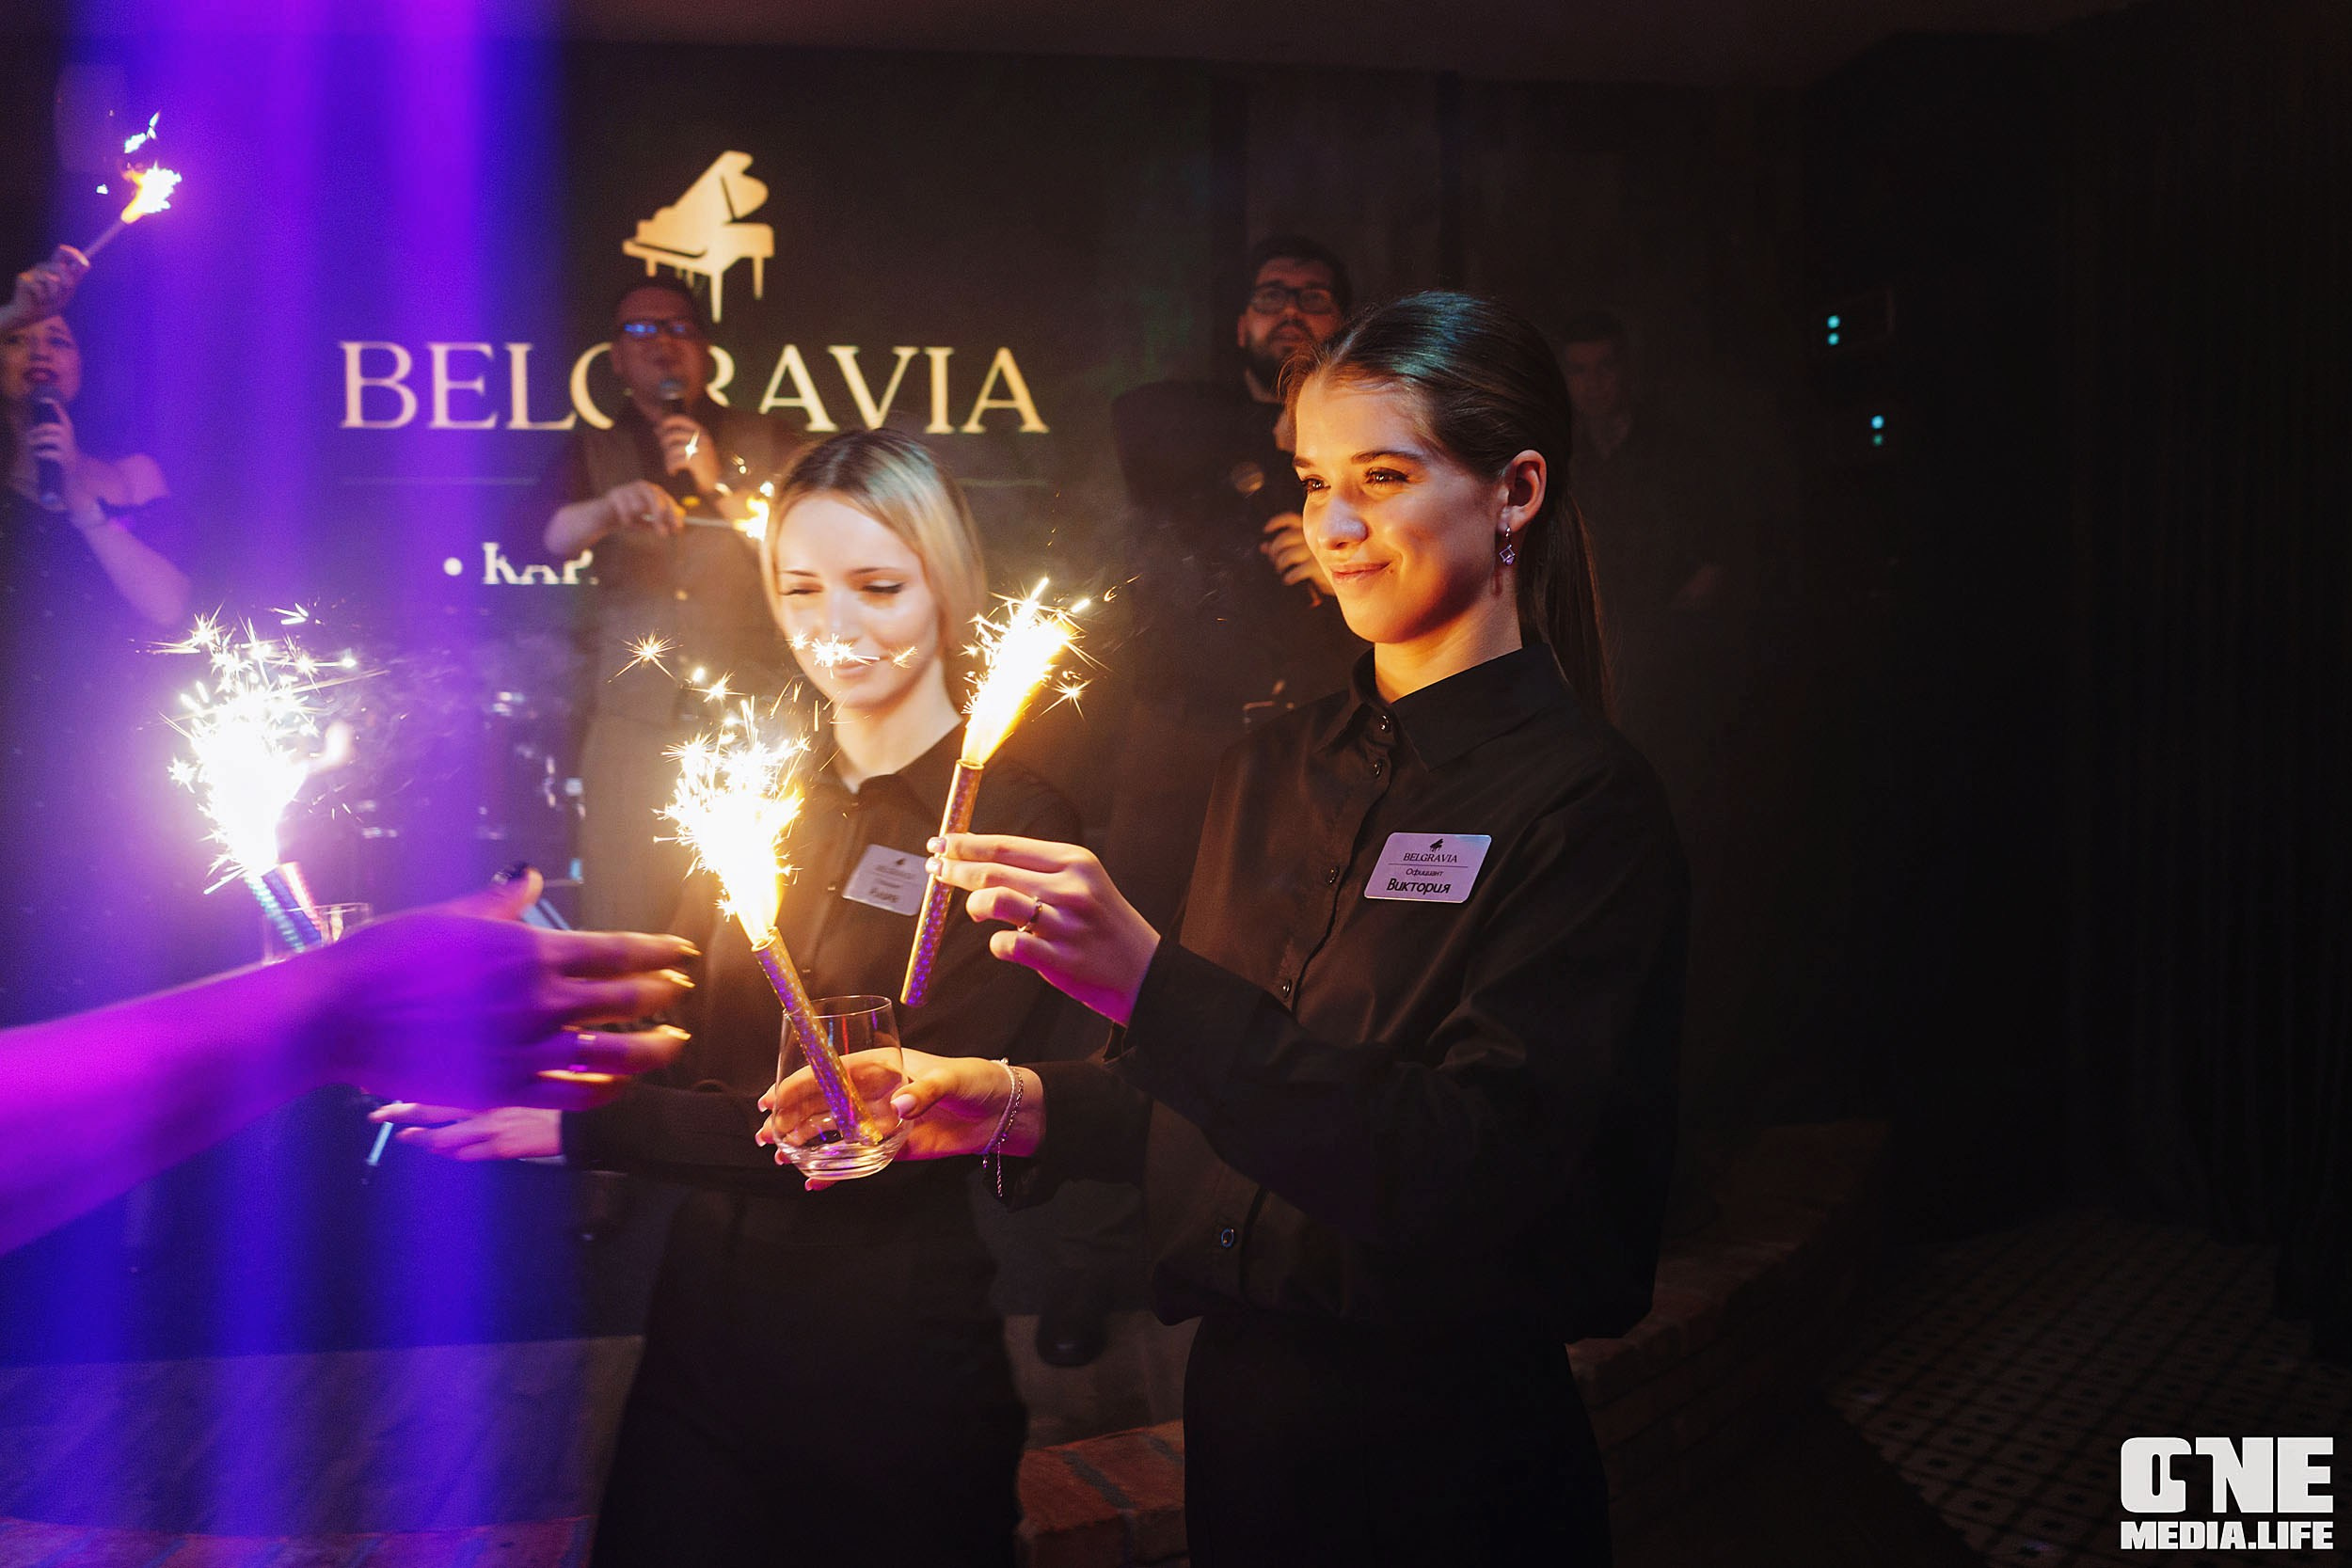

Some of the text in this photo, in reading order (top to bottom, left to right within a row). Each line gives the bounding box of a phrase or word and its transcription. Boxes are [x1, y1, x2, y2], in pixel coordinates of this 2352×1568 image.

[1403, 852, 1458, 863] BELGRAVIA
[1405, 867, 1445, 877] Официант
[1386, 878, 1452, 895] Виктория
